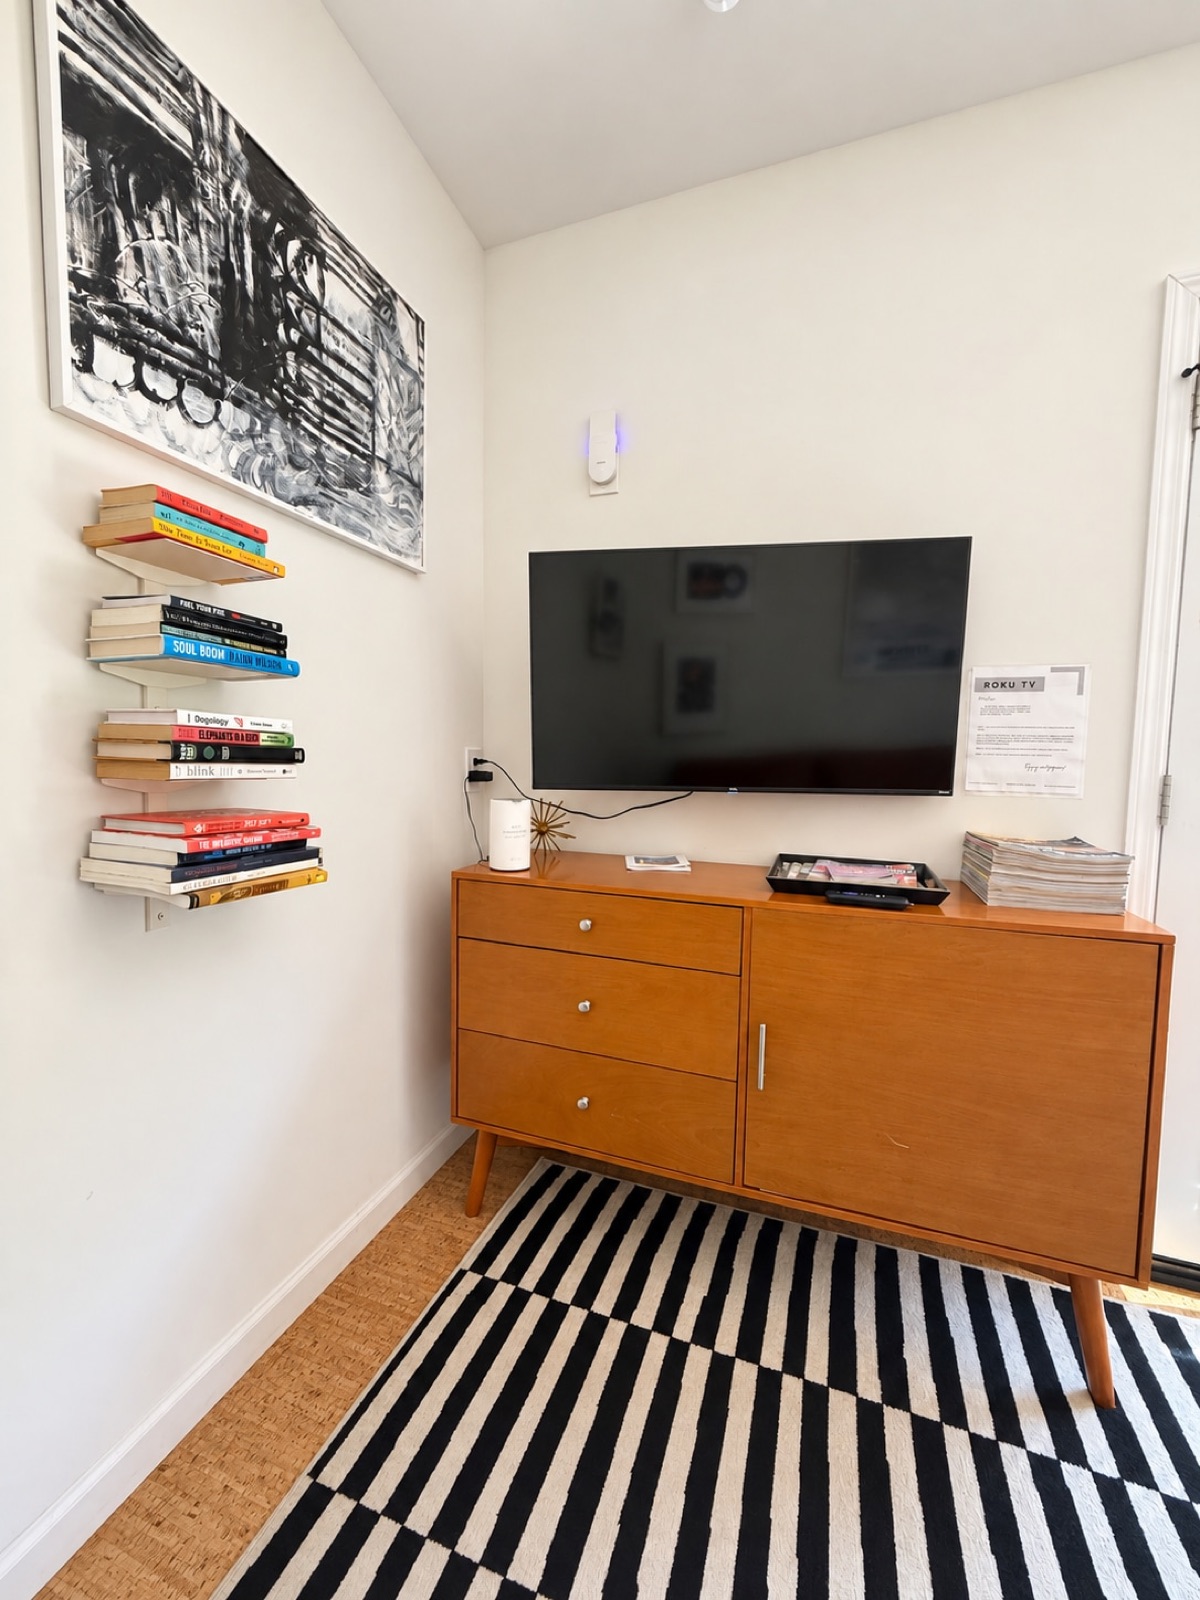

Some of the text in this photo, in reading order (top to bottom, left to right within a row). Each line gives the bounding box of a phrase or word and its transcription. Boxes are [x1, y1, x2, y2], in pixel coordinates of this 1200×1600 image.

[173, 640, 198, 656] SOUL
[983, 681, 1016, 689] ROKU
[194, 714, 230, 727] Dogology
[186, 765, 215, 777] blink
